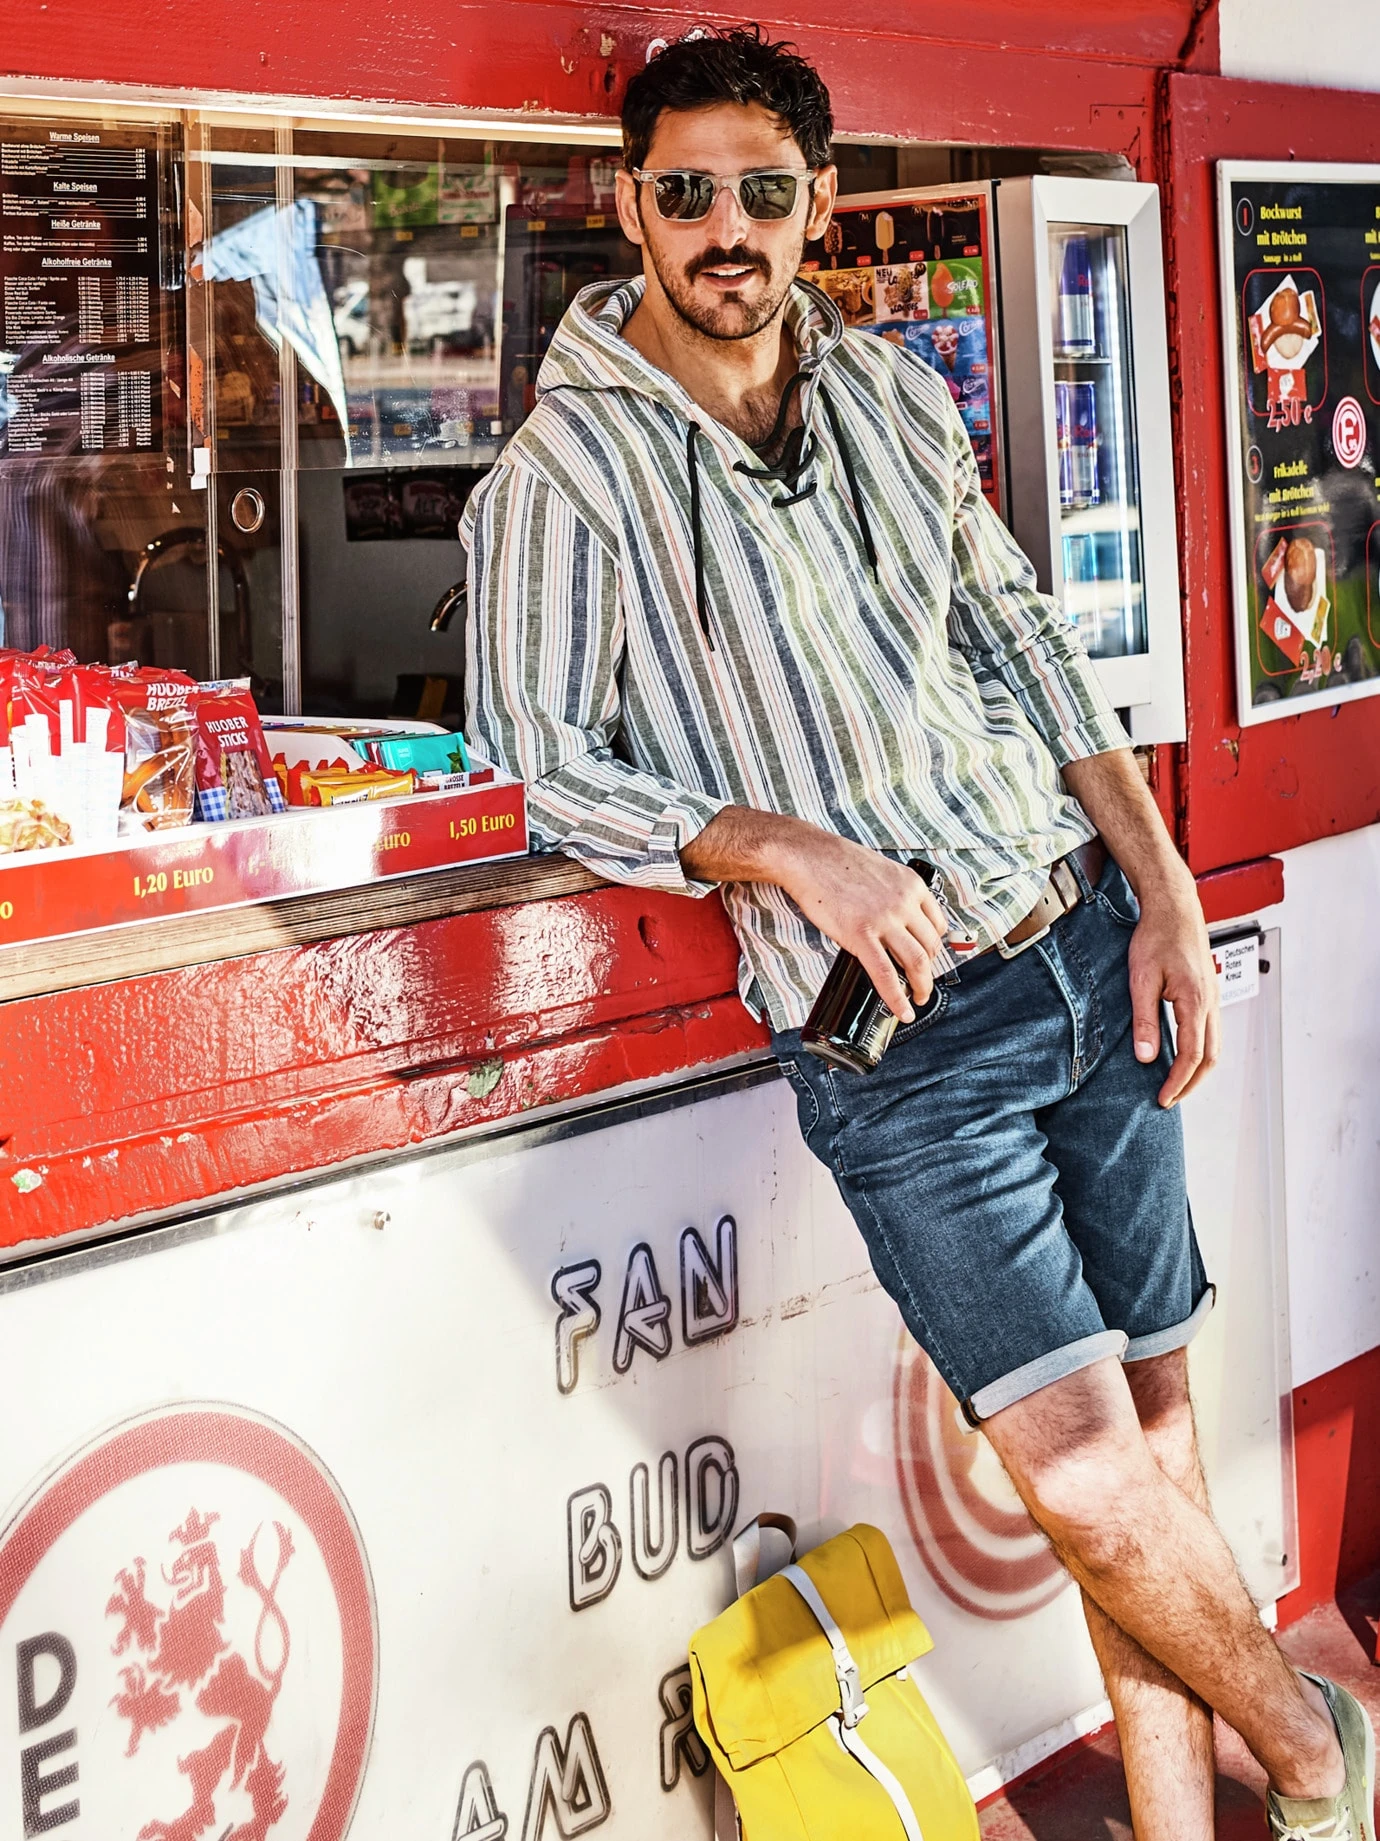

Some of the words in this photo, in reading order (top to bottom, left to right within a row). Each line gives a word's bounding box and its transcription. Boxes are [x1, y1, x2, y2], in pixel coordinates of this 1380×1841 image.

[50, 132, 72, 141] Warme
[74, 132, 100, 142] Speisen
[54, 182, 70, 191] Kalte
[72, 182, 98, 192] Speisen
[1260, 203, 1302, 220] Bockwurst
[51, 220, 70, 228] Heiße
[71, 220, 101, 229] Getränke
[1257, 230, 1270, 246] mit
[1272, 228, 1307, 246] Brötchen
[42, 258, 81, 267] Alkoholfreie
[82, 258, 112, 268] Getränke
[876, 268, 893, 278] NEU
[42, 354, 84, 363] Alkoholische
[86, 354, 115, 362] Getränke
[1266, 397, 1301, 432] 2,50
[1274, 460, 1308, 478] Frikadelle
[1268, 488, 1281, 504] mit
[1282, 484, 1314, 501] Brötchen
[1300, 646, 1331, 686] 2,20
[146, 682, 200, 696] HUOBER
[146, 697, 188, 712] BREZEL
[205, 716, 248, 734] HUOBER
[218, 732, 248, 748] STICKS
[450, 818, 477, 842] 1,50
[481, 813, 516, 832] Euro
[134, 872, 168, 898] 1,20
[173, 866, 214, 889] Euro
[1225, 944, 1254, 960] Deutsches
[1225, 960, 1242, 970] Rotes
[1225, 971, 1242, 982] Kreuz
[551, 1214, 739, 1395] FAN
[567, 1435, 740, 1612] BUD
